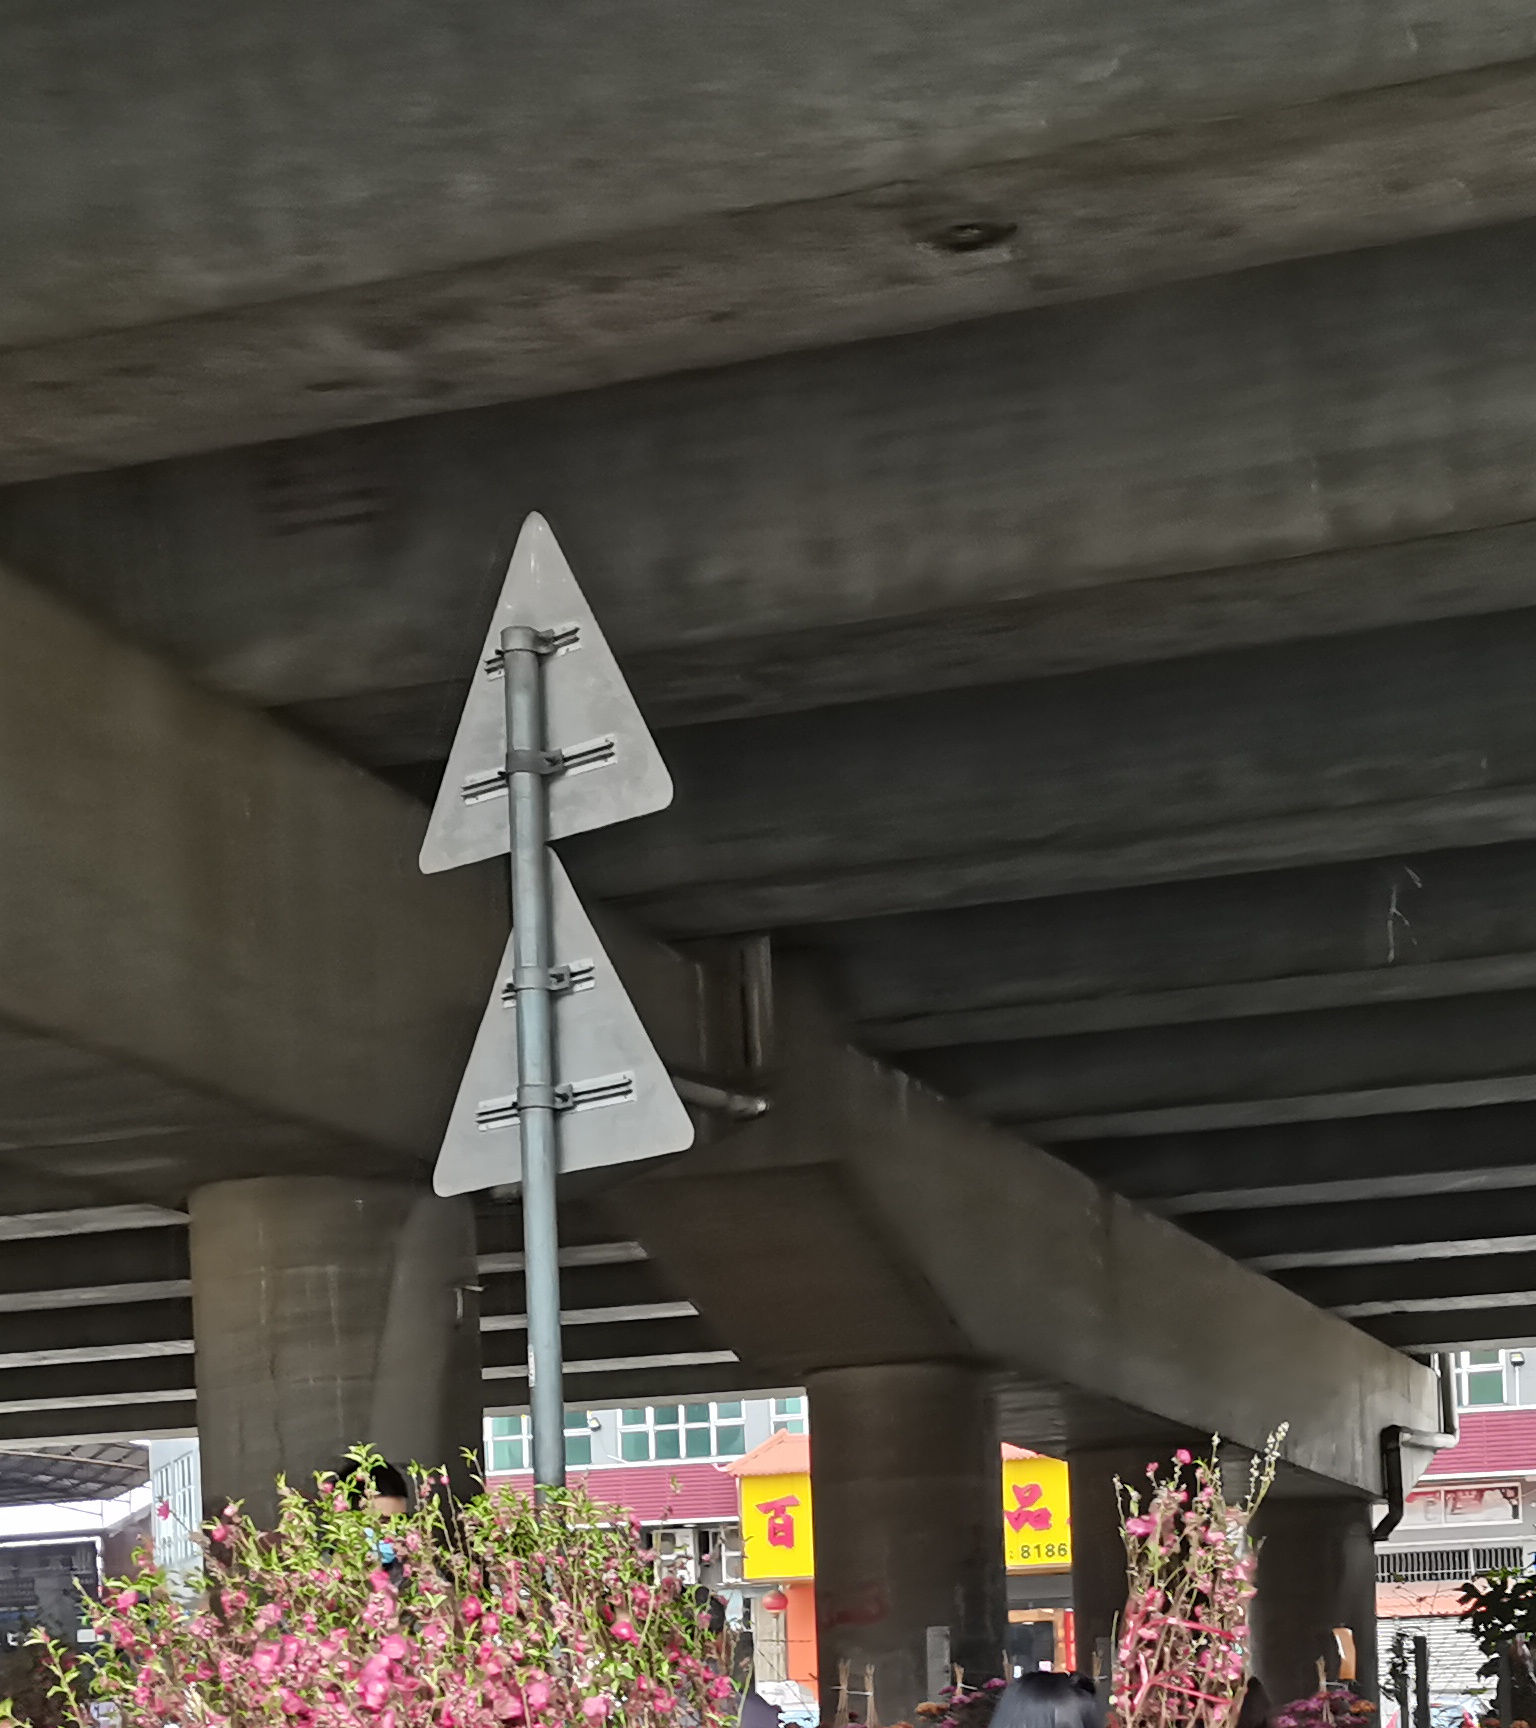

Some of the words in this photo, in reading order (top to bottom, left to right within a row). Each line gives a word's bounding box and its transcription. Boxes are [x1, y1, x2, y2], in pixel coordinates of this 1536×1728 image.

[755, 1495, 800, 1549] 百
[1004, 1484, 1052, 1532] 品
[1021, 1543, 1068, 1559] 8186
